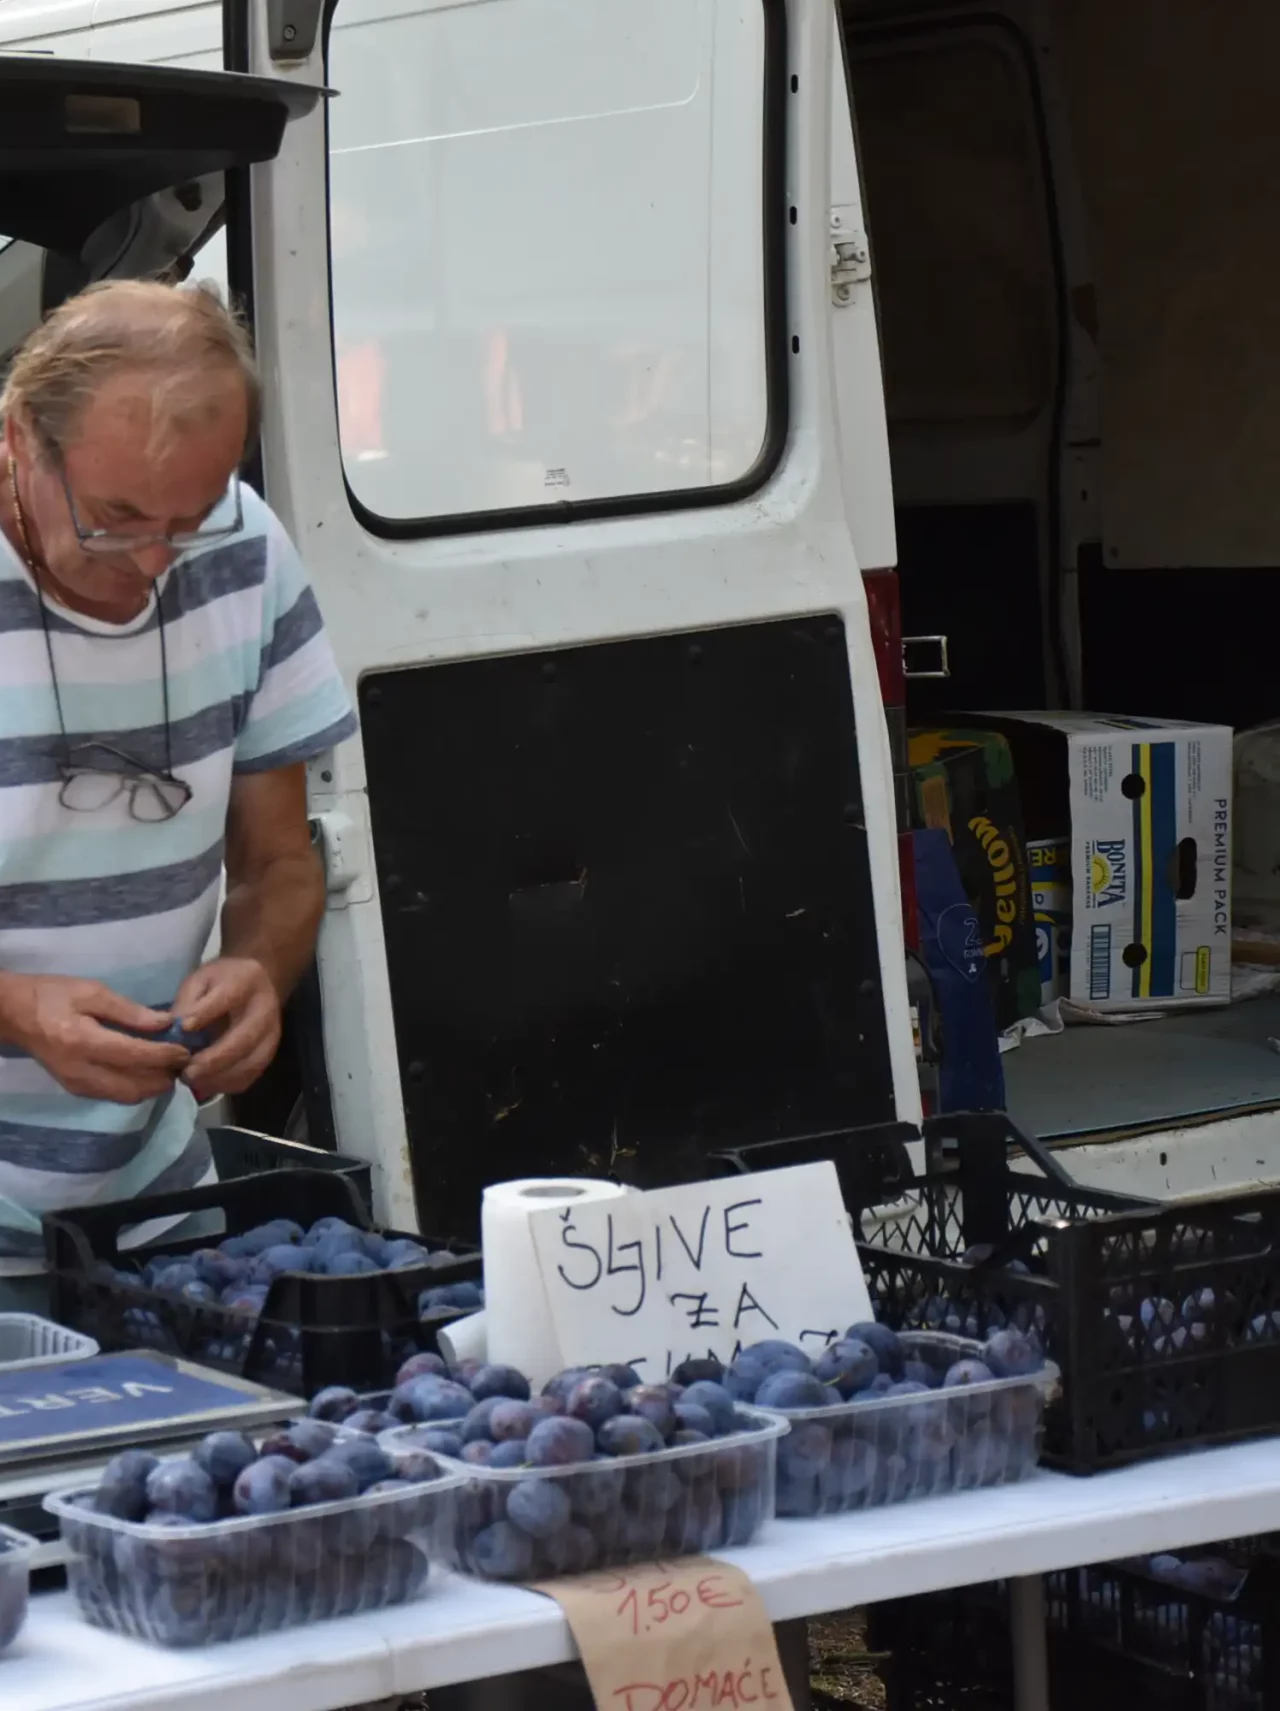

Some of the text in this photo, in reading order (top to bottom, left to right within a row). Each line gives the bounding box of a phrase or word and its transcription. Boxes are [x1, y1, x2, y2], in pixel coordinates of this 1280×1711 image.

[1097, 839, 1126, 909] BONITA
[1213, 799, 1227, 935] PREMIUM PACK
[669, 1282, 779, 1330] ZA
